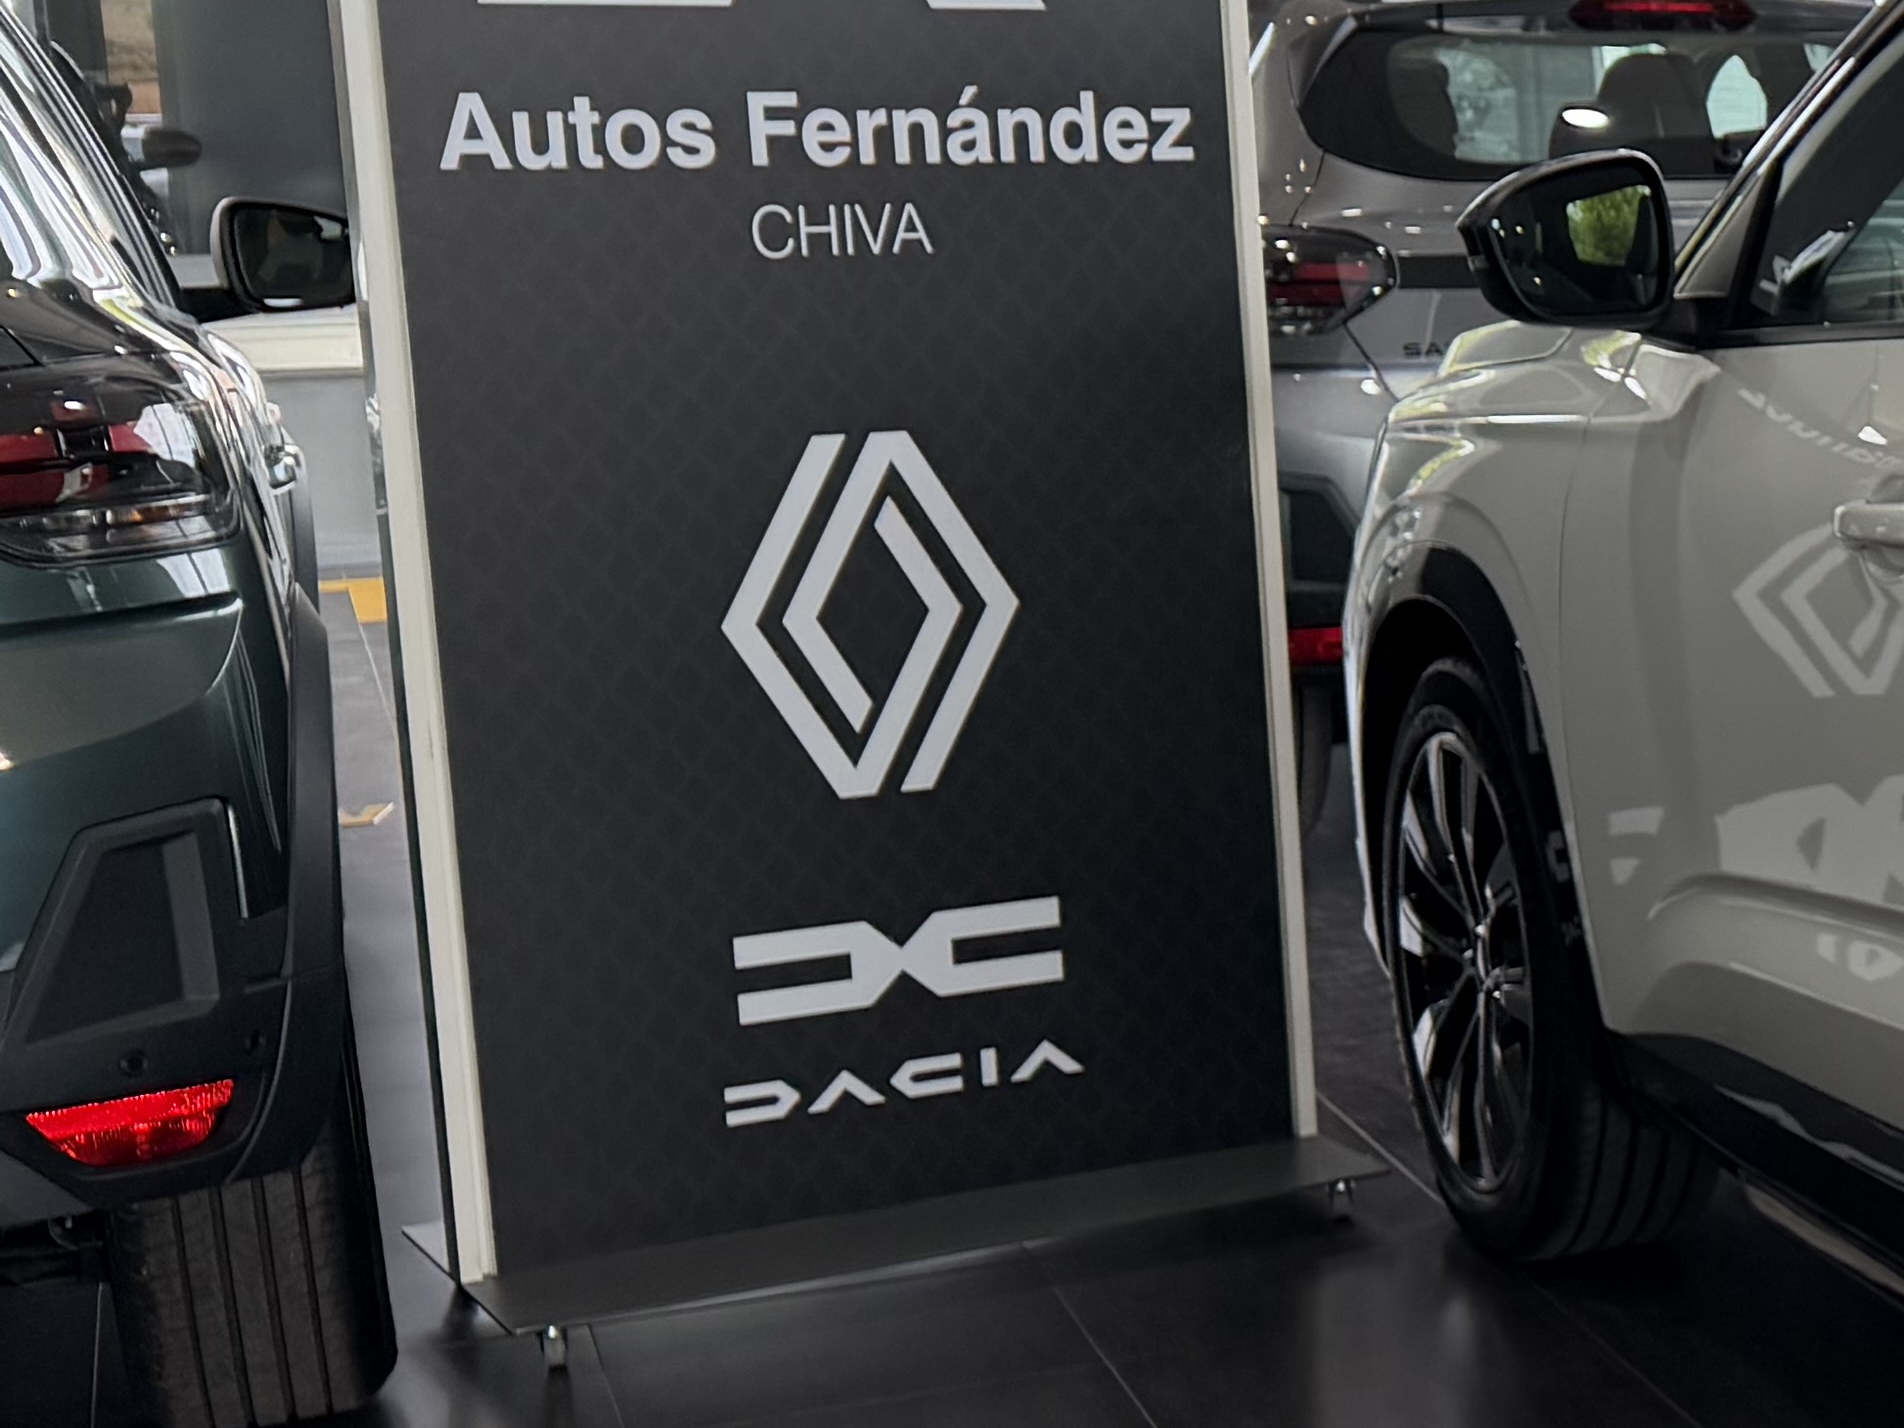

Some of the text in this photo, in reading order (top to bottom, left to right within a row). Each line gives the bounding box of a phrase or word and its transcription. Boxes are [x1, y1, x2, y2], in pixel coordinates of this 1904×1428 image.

[439, 84, 1195, 171] Autos Fernández
[750, 202, 935, 260] CHIVA
[723, 1038, 1086, 1128] DACIA
